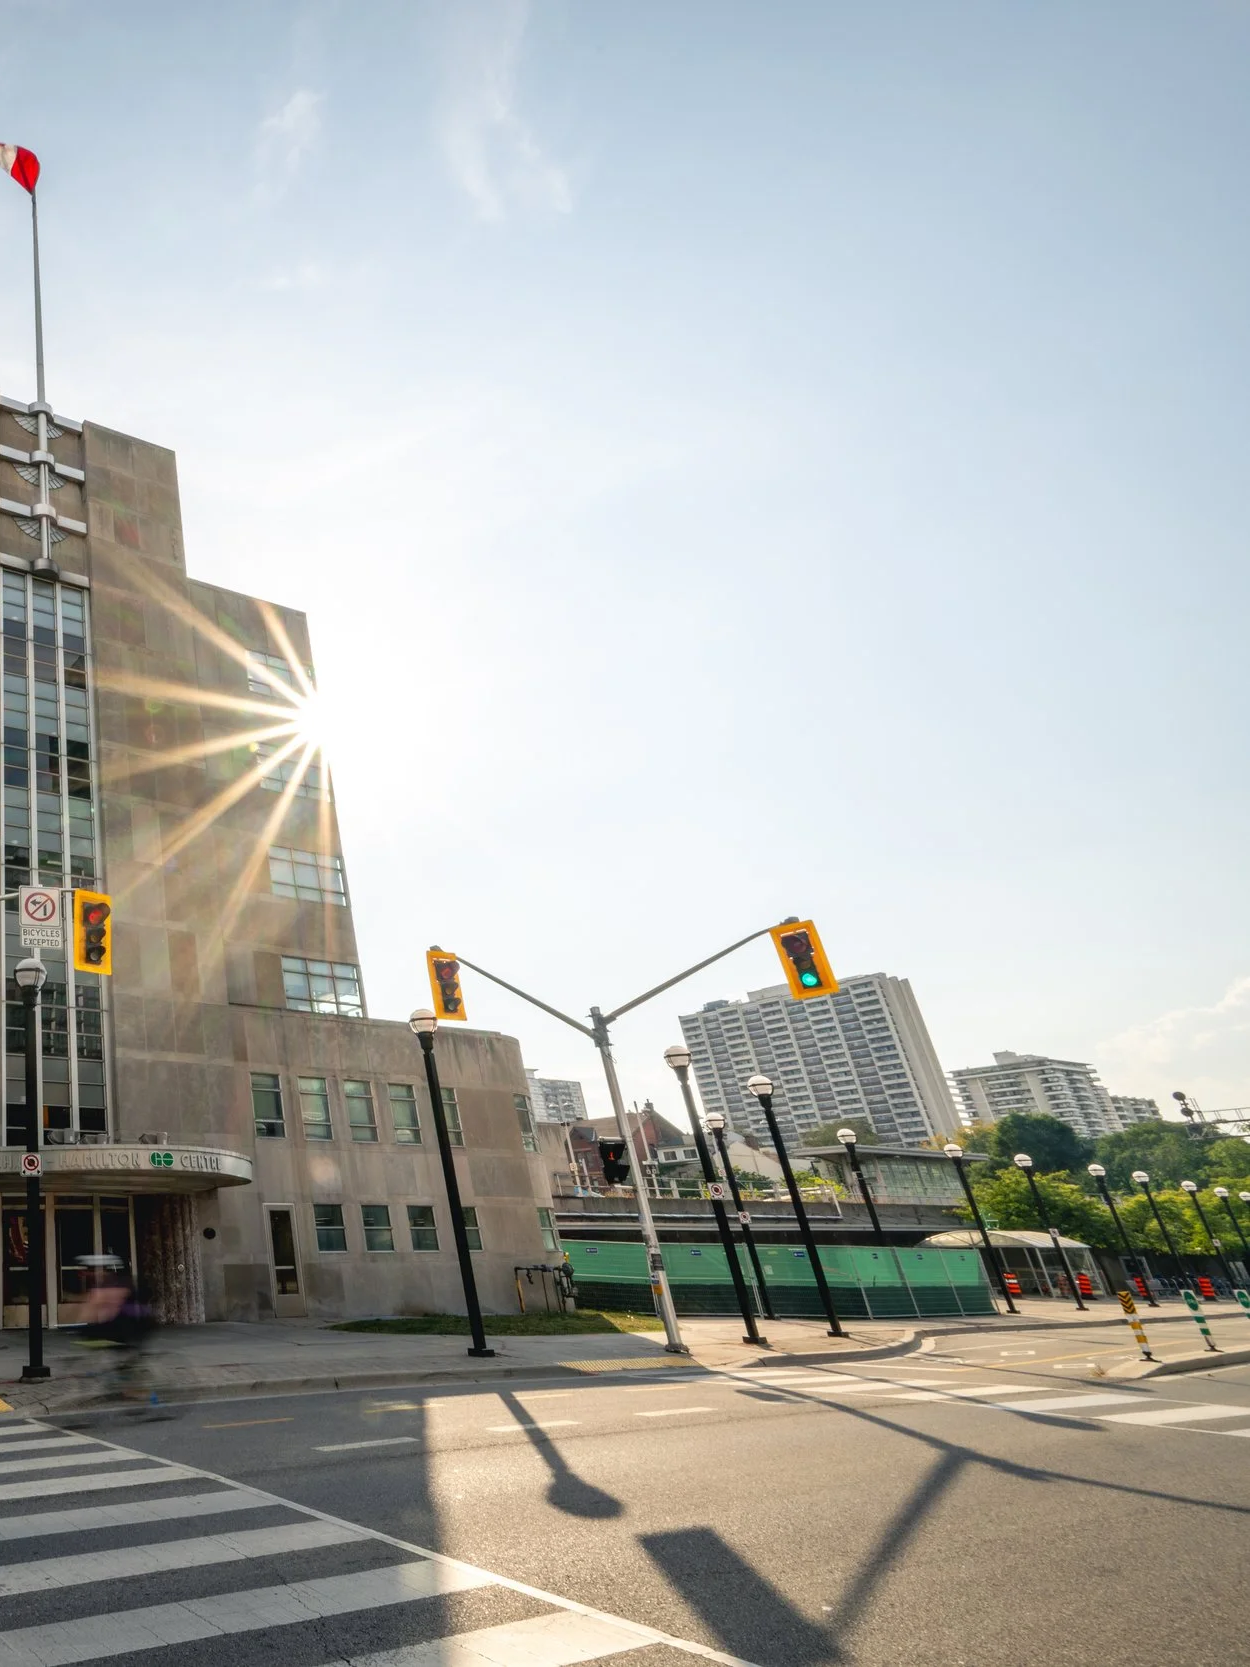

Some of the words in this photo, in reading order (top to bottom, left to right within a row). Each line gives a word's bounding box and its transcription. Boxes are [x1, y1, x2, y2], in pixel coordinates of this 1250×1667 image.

[23, 928, 60, 938] BICYCLES
[23, 938, 60, 947] EXCEPTED
[59, 1152, 141, 1169] HAMILTON
[149, 1150, 175, 1168] GO
[180, 1154, 221, 1171] CENTRE
